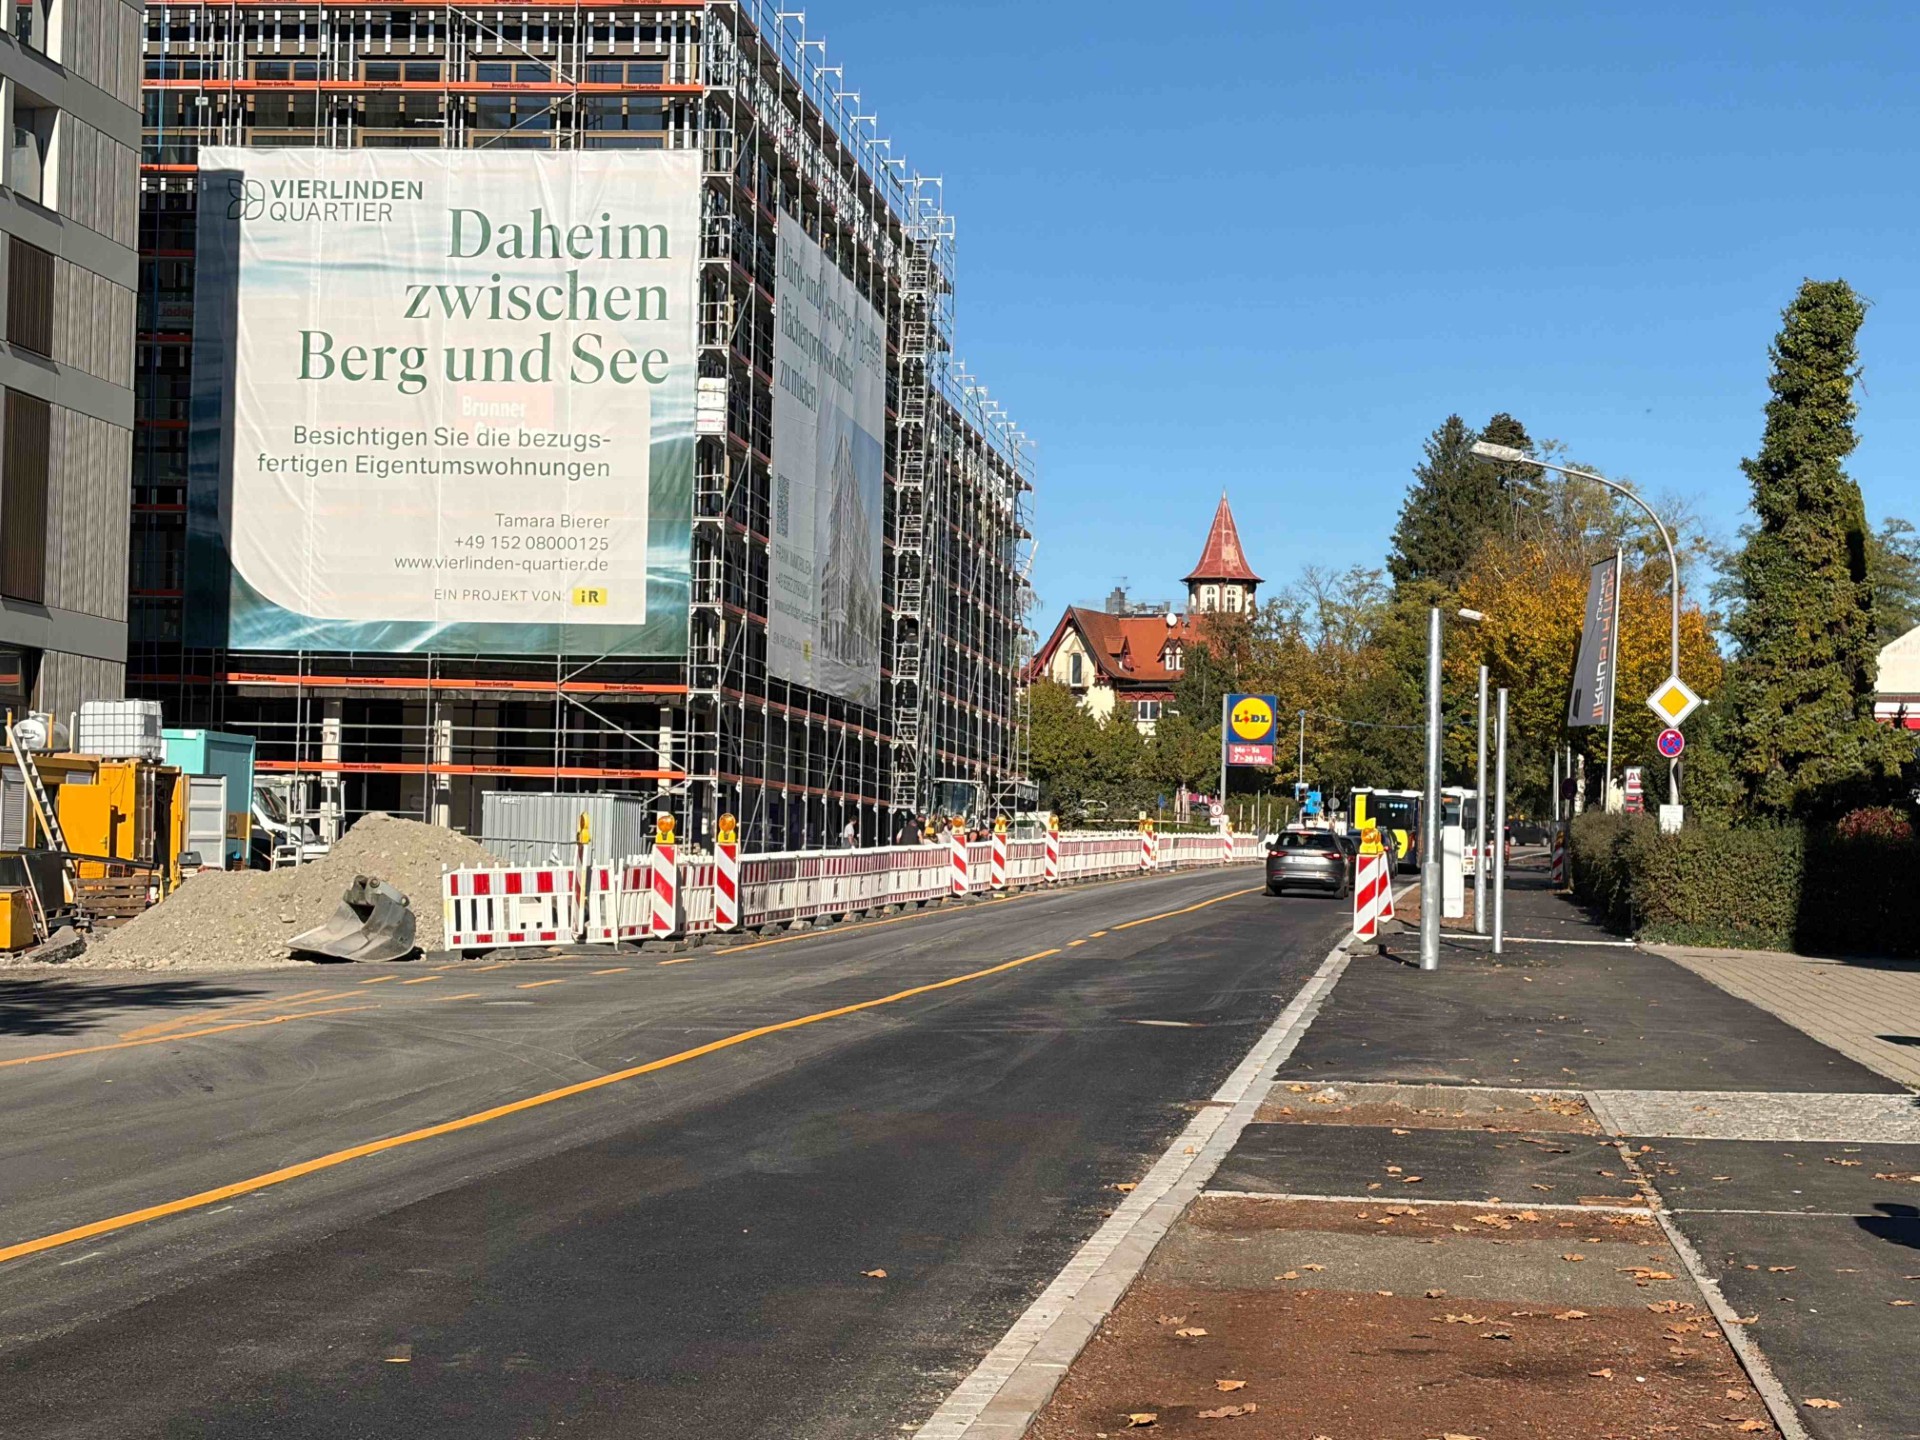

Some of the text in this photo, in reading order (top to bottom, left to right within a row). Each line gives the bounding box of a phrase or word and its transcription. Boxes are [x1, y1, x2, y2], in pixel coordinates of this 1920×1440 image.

[270, 179, 423, 200] VIERLINDEN
[269, 201, 393, 222] QUARTIER
[446, 207, 671, 261] Daheim
[403, 269, 669, 322] zwischen
[297, 330, 669, 394] Berg und See
[294, 426, 428, 451] Besichtigen
[434, 426, 470, 447] Sie
[476, 427, 511, 447] die
[518, 428, 612, 453] bezugs-
[257, 452, 610, 482] fertigen Eigentumswohnungen
[495, 513, 611, 529] Tamara Bierer
[454, 535, 609, 551] +49 152 08000125
[394, 555, 609, 573] www.vierlinden-quartier.de
[434, 589, 457, 600] EIN
[462, 589, 528, 602] PROJEKT
